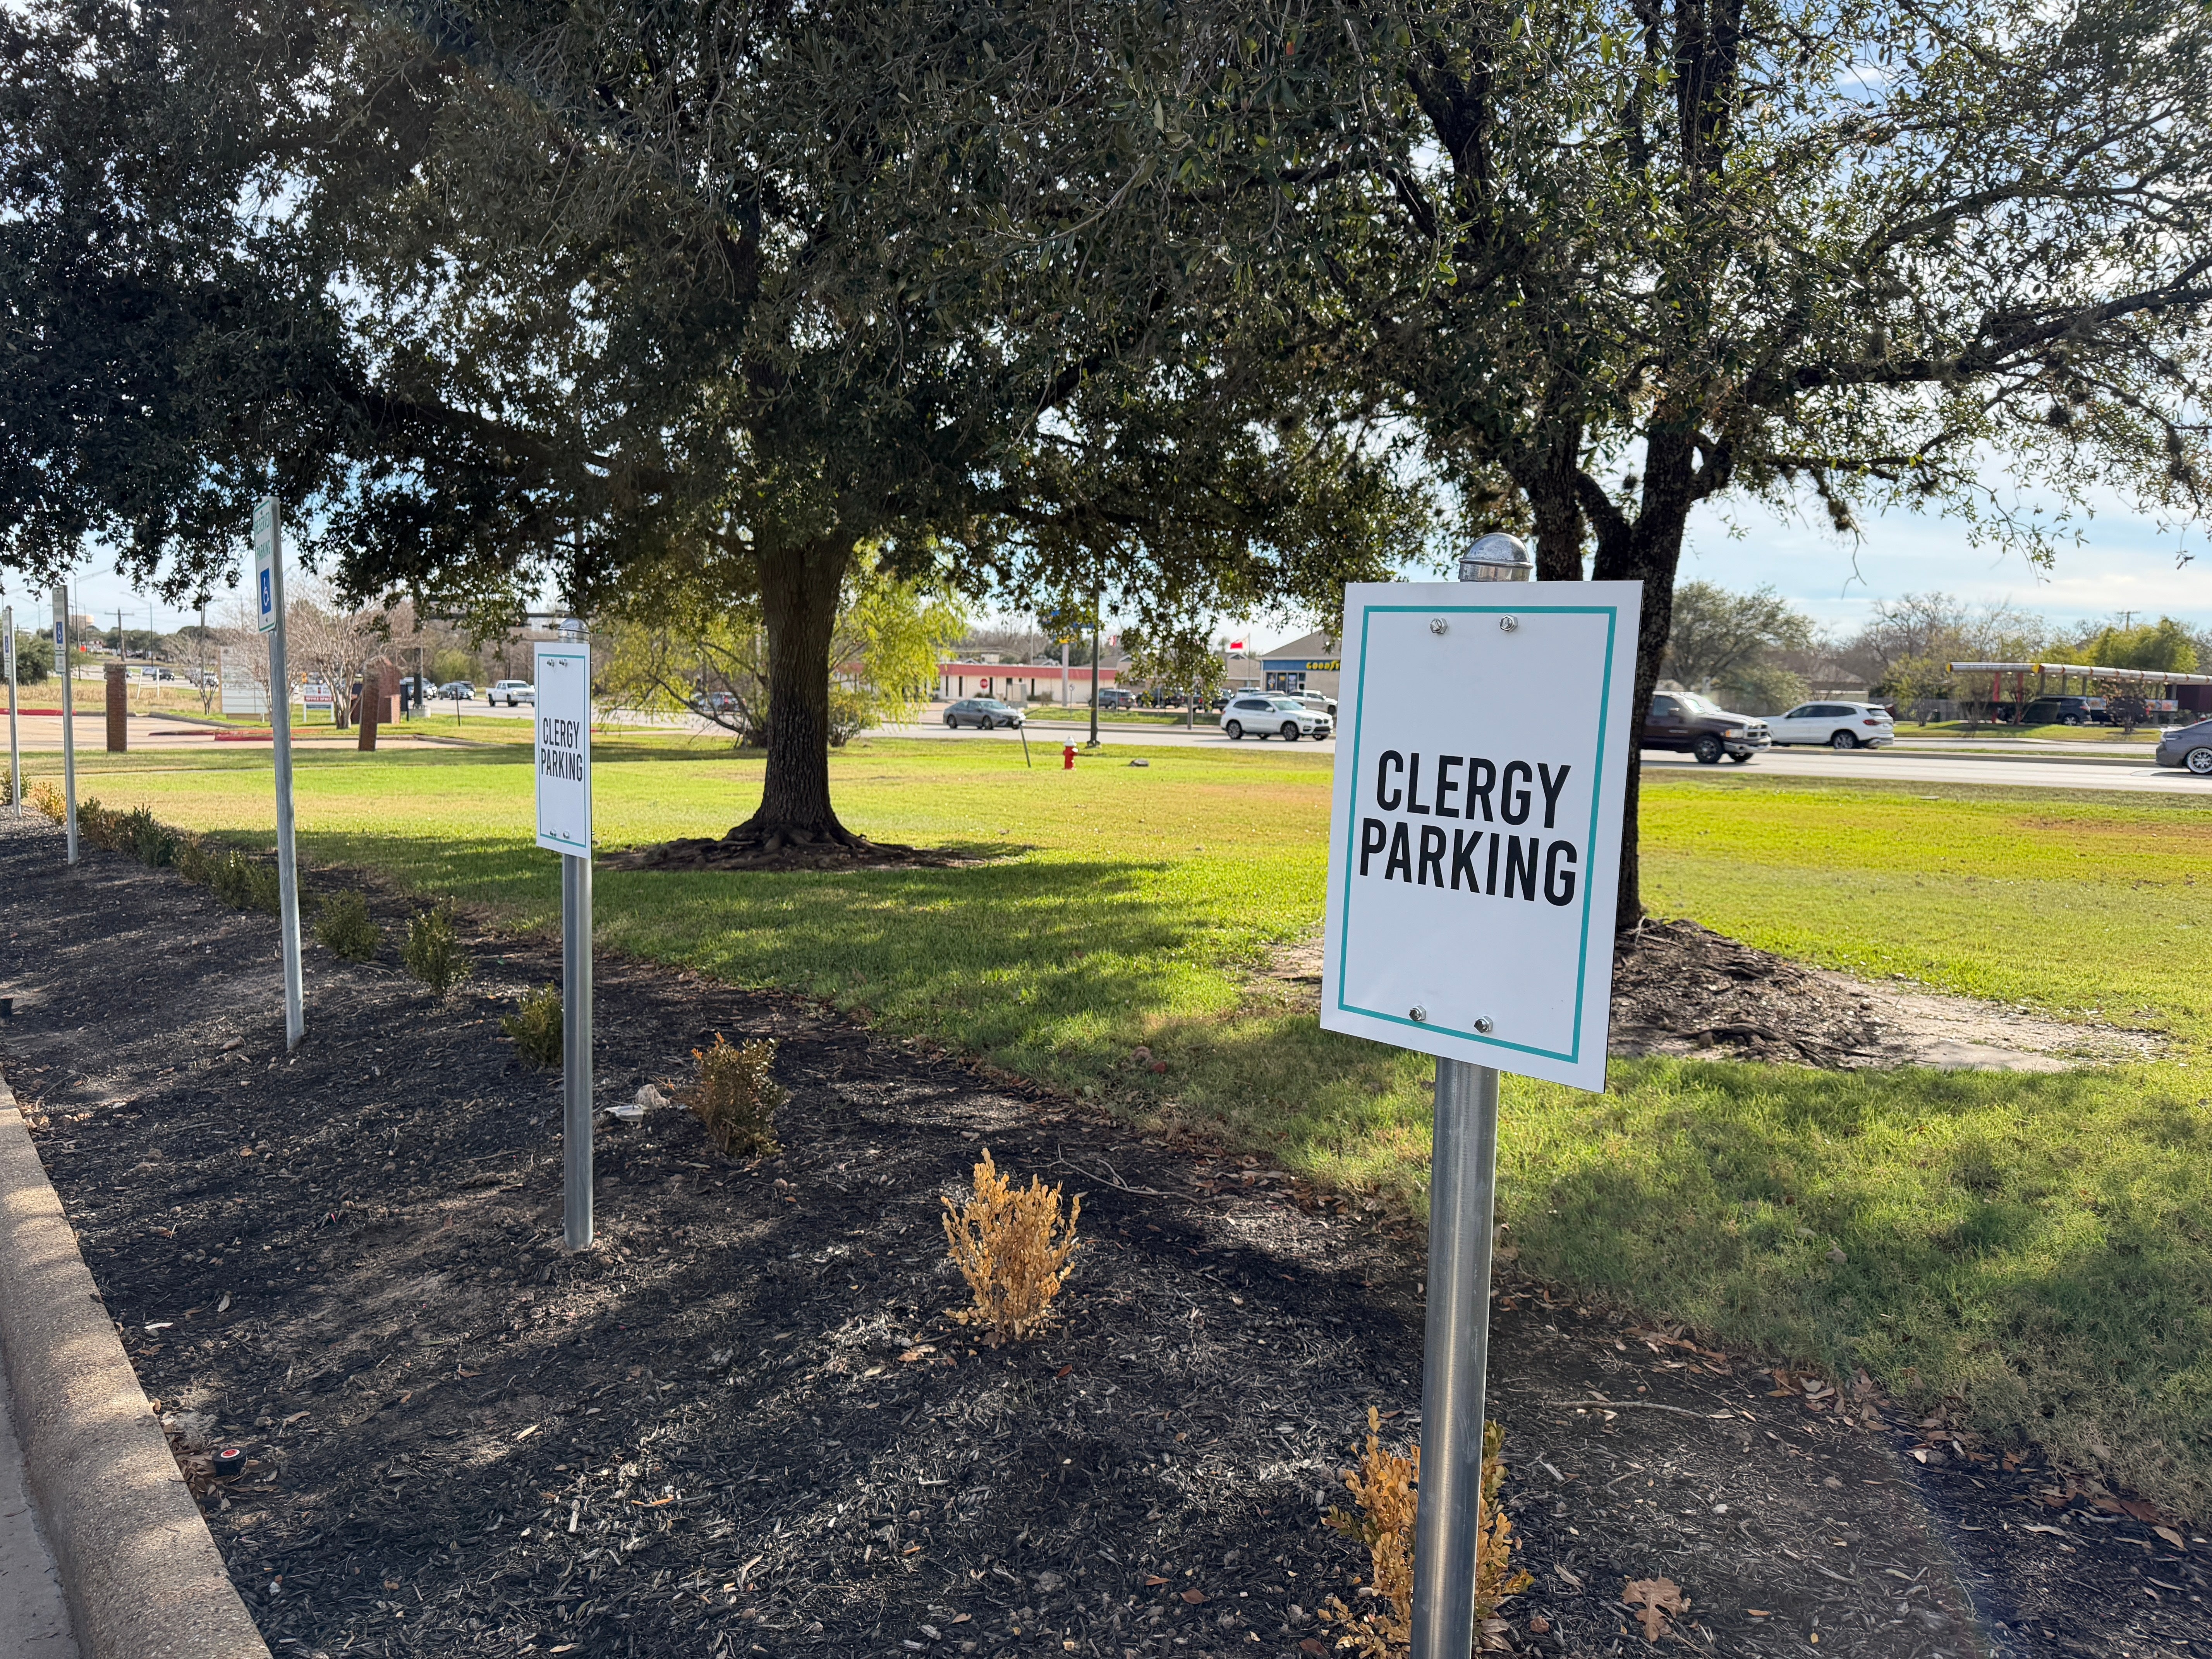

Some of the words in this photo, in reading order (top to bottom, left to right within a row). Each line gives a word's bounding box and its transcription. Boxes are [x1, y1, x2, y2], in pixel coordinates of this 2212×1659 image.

[543, 717, 580, 749] CLERGY
[541, 747, 583, 782] PARKING
[1376, 750, 1571, 829] CLERGY
[1360, 817, 1577, 907] PARKING
